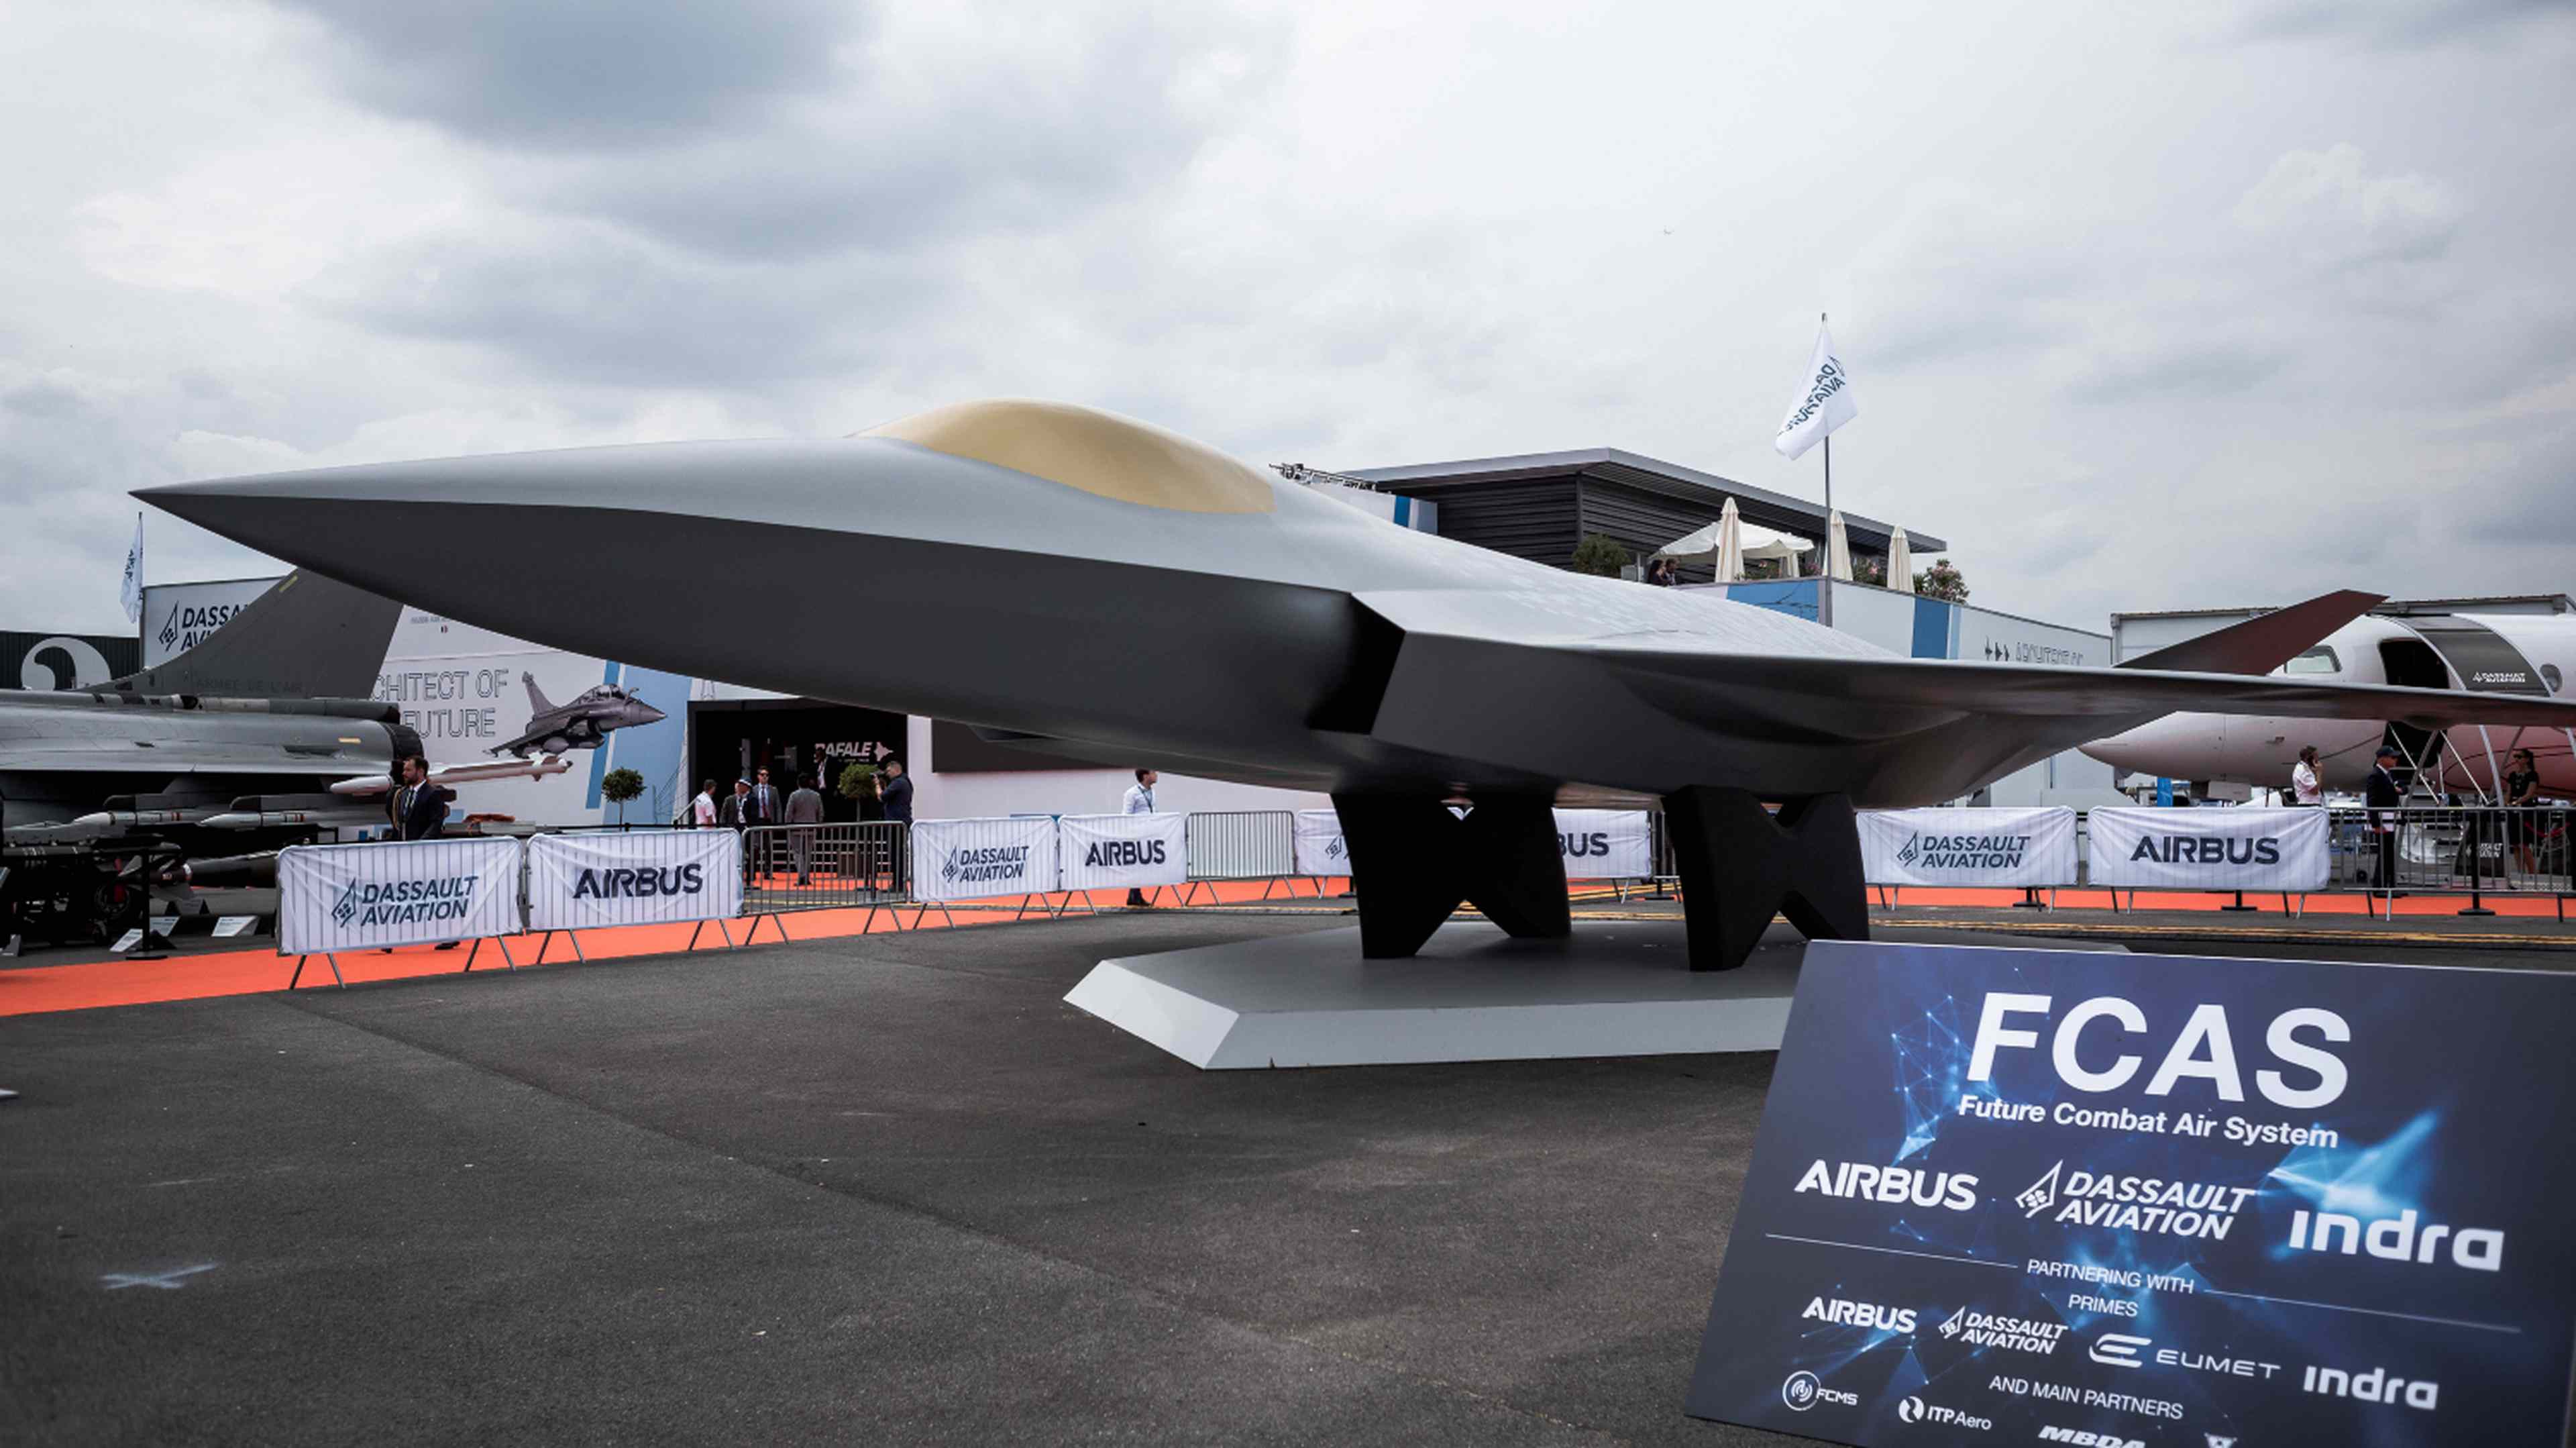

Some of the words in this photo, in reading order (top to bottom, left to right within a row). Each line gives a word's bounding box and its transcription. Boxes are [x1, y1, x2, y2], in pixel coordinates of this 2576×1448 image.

[182, 605, 249, 628] DASSA
[370, 671, 470, 701] CHITECT
[476, 669, 508, 698] OF
[402, 707, 496, 739] FUTURE
[960, 845, 1029, 864] DASSAULT
[1085, 839, 1165, 868] AIRBUS
[1923, 835, 2031, 852] DASSAULT
[2130, 836, 2281, 865] AIRBUS
[959, 862, 1024, 883] AVIATION
[1921, 852, 2022, 869] AVIATION
[362, 876, 478, 903] DASSAULT
[573, 864, 703, 900] AIRBUS
[361, 898, 469, 927] AVIATION
[1967, 992, 2351, 1109] FCAS
[1958, 1094, 2047, 1123] Future
[2054, 1102, 2167, 1135] Combat
[2172, 1113, 2216, 1139] Air
[2222, 1117, 2338, 1149] System
[1794, 1159, 1979, 1211] AIRBUS
[2063, 1172, 2255, 1213] DASSAULT
[2055, 1199, 2236, 1241] AVIATION
[2289, 1208, 2504, 1272] indra
[2027, 1259, 2141, 1288] PARTNERING
[2146, 1274, 2195, 1294] WITH
[1802, 1296, 1917, 1334] AIRBUS
[2068, 1294, 2139, 1317] PRIMES
[1964, 1312, 2068, 1339] DASSAULT
[1961, 1329, 2055, 1355] AVIATION
[2156, 1349, 2281, 1379] EUMET
[1816, 1388, 1858, 1406] FCMS
[1989, 1375, 2029, 1395] AND
[2032, 1380, 2082, 1403] MAIN
[2084, 1388, 2184, 1419] PARTNERS
[2303, 1365, 2438, 1410] indra
